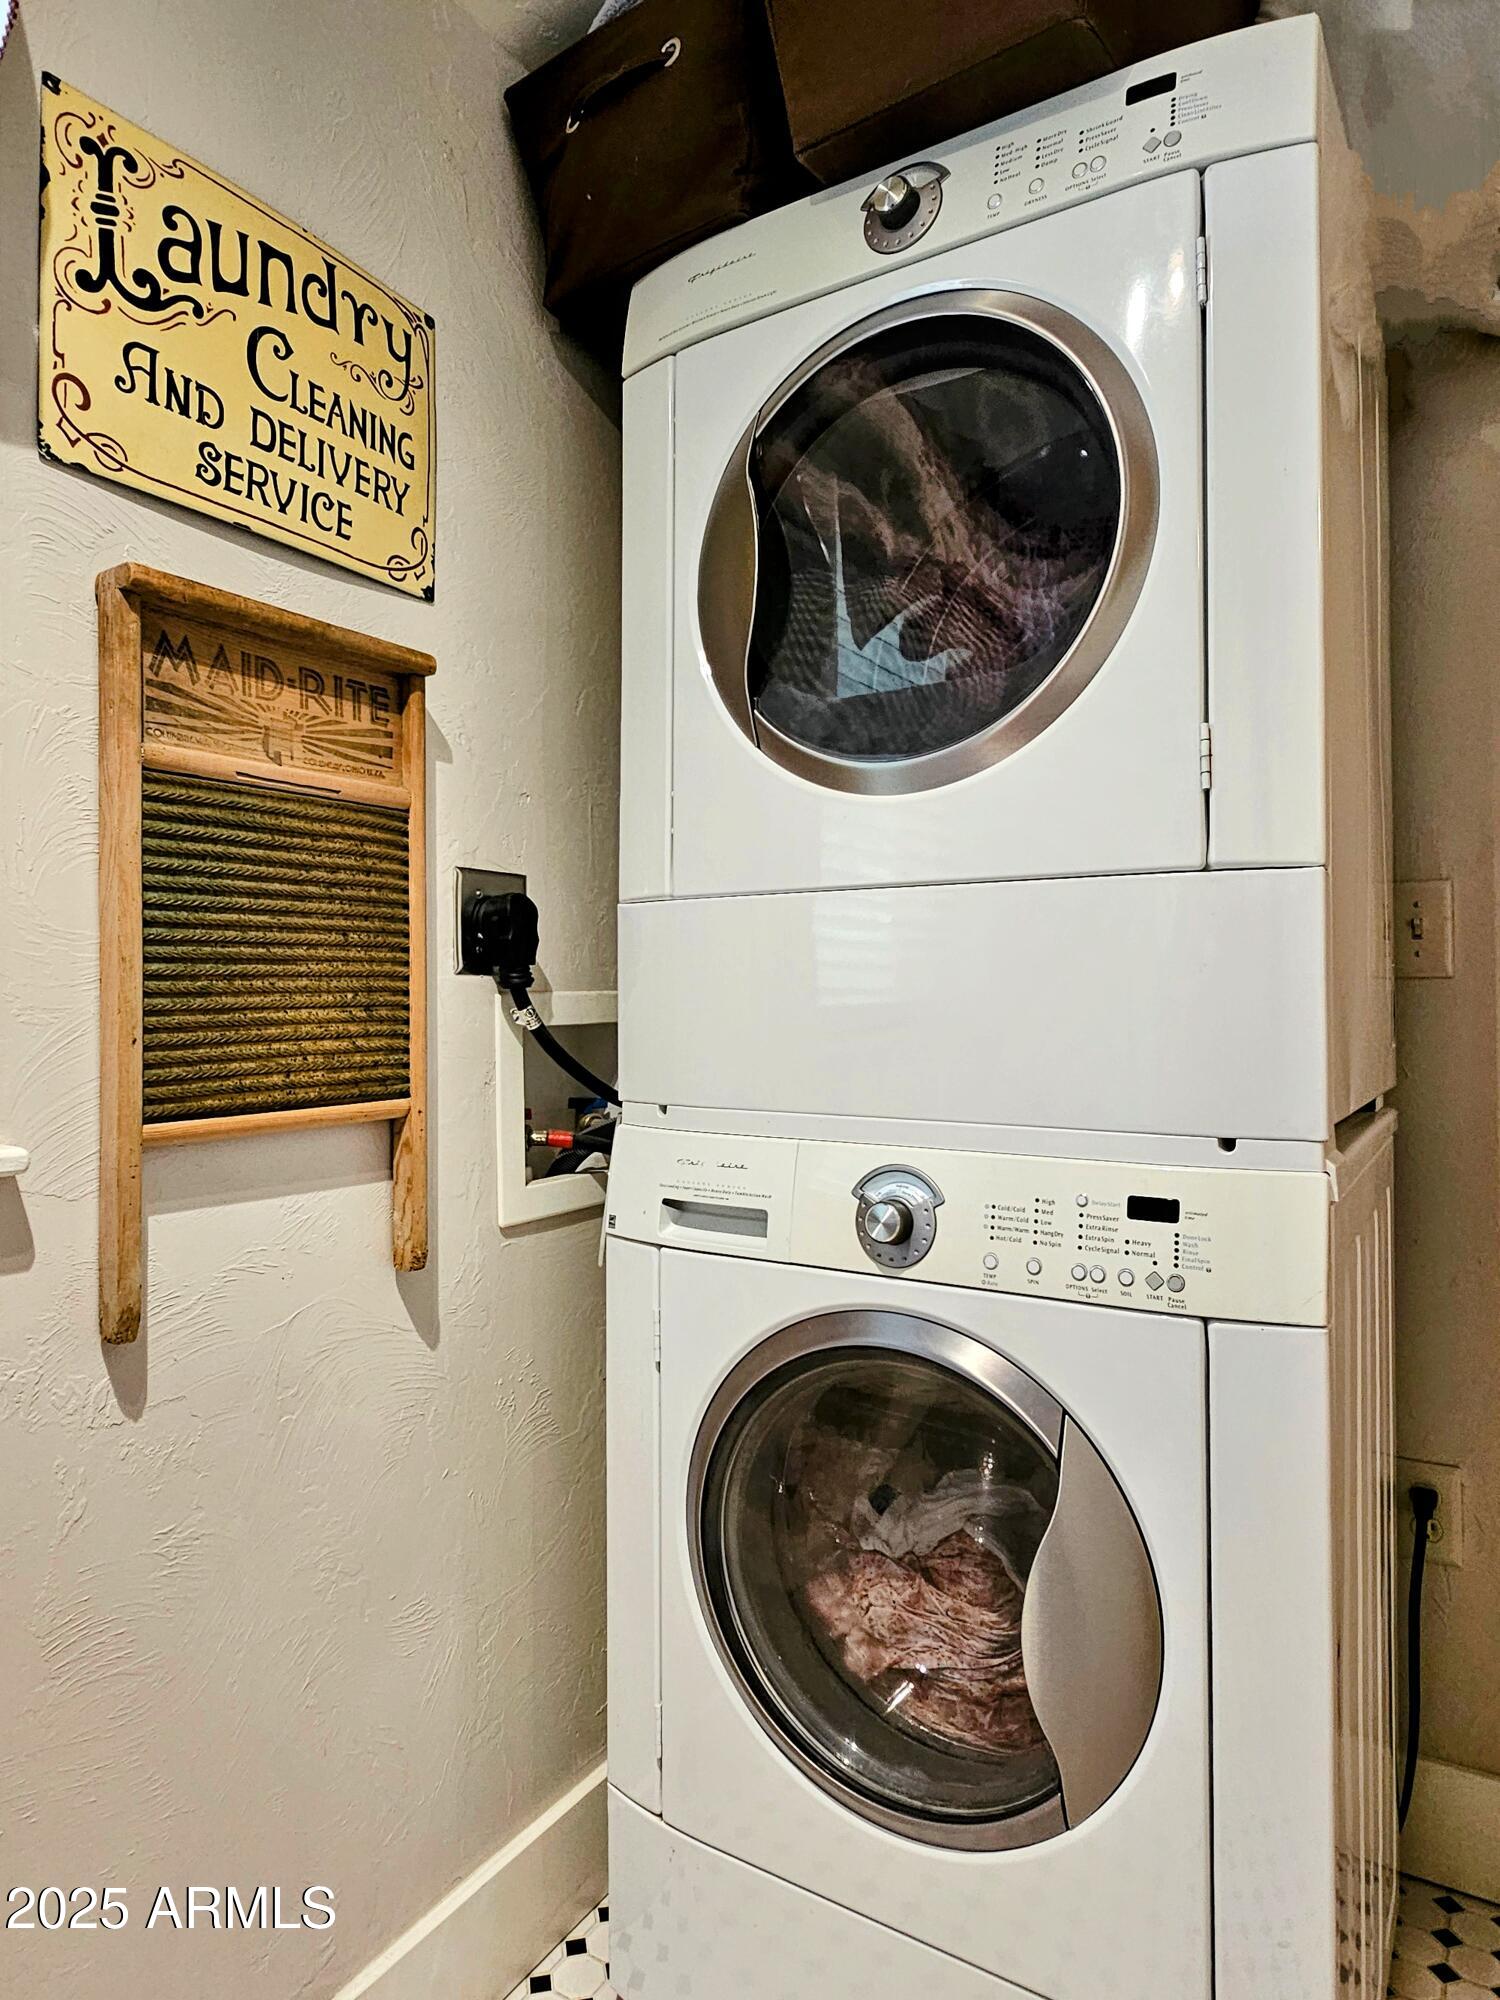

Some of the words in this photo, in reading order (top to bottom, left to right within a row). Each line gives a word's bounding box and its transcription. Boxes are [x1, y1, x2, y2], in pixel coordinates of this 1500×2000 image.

[75, 135, 413, 402] Laundry
[114, 341, 225, 430] AND
[249, 406, 410, 516] DELIVERY
[196, 441, 353, 541] SERVICE
[149, 629, 391, 726] MAID-RITE
[997, 1204, 1026, 1213] Cold/Cold
[1131, 1250, 1155, 1258] Normal
[1065, 1284, 1089, 1292] OPTIONS
